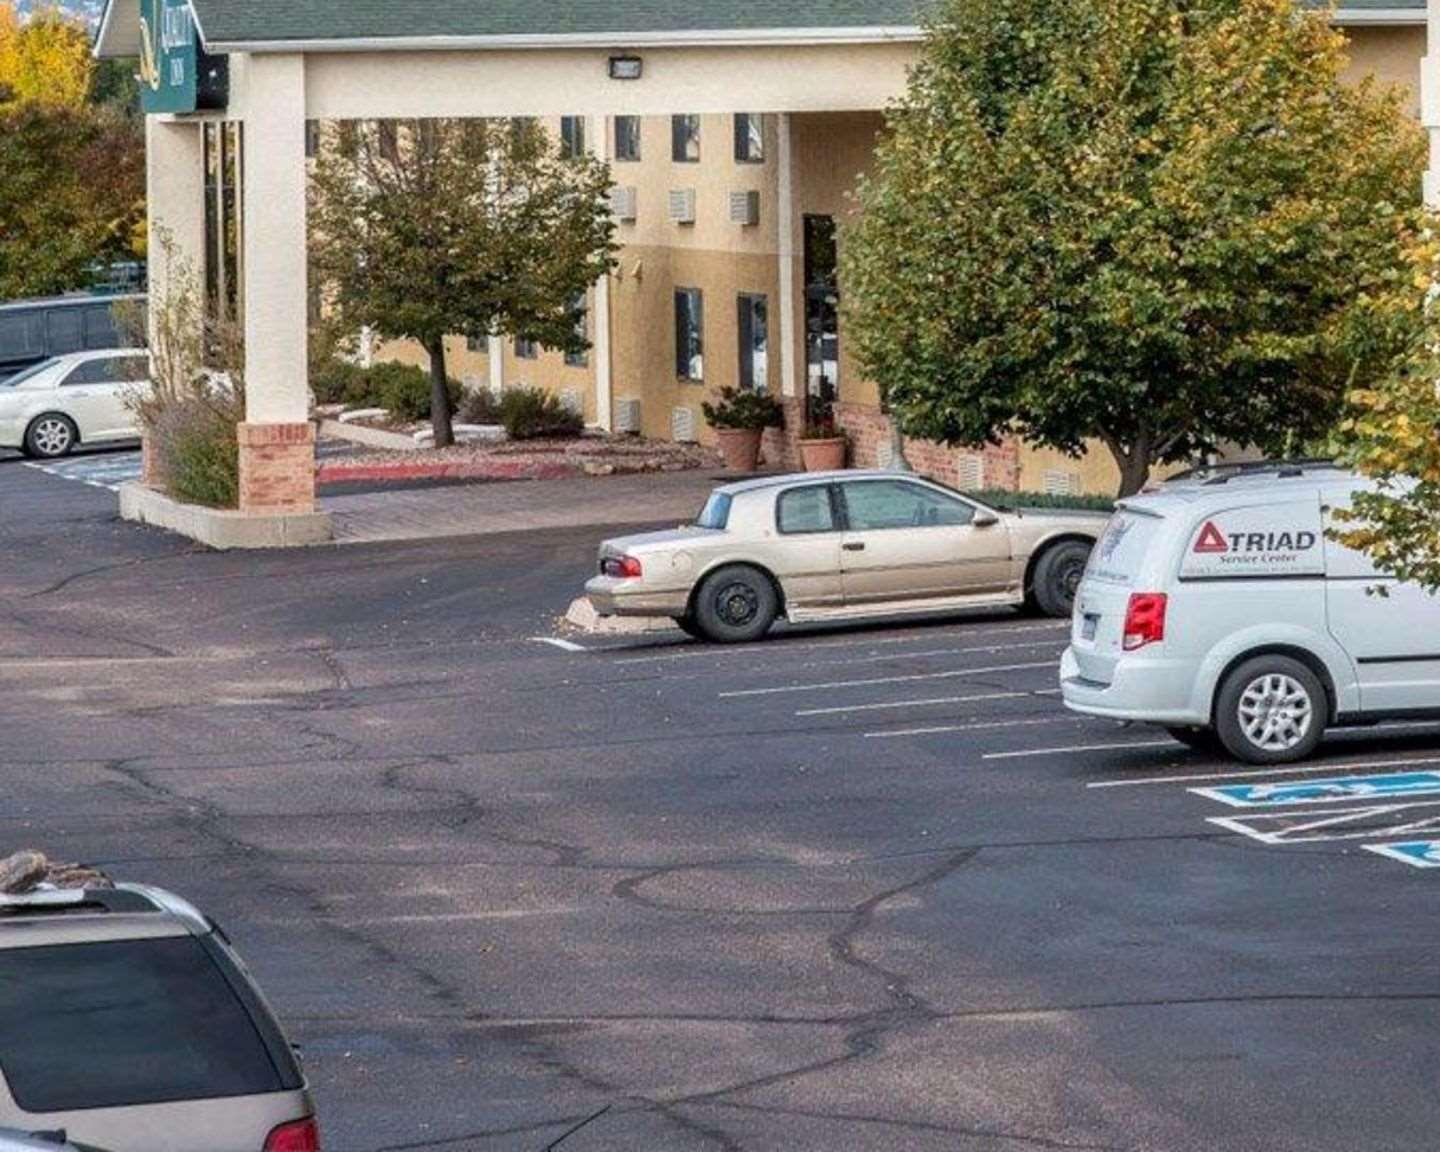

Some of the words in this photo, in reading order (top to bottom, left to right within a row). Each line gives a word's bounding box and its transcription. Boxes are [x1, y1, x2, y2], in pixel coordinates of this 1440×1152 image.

[1228, 531, 1316, 552] TRIAD
[1220, 554, 1258, 564] Service
[1261, 553, 1298, 563] Center
